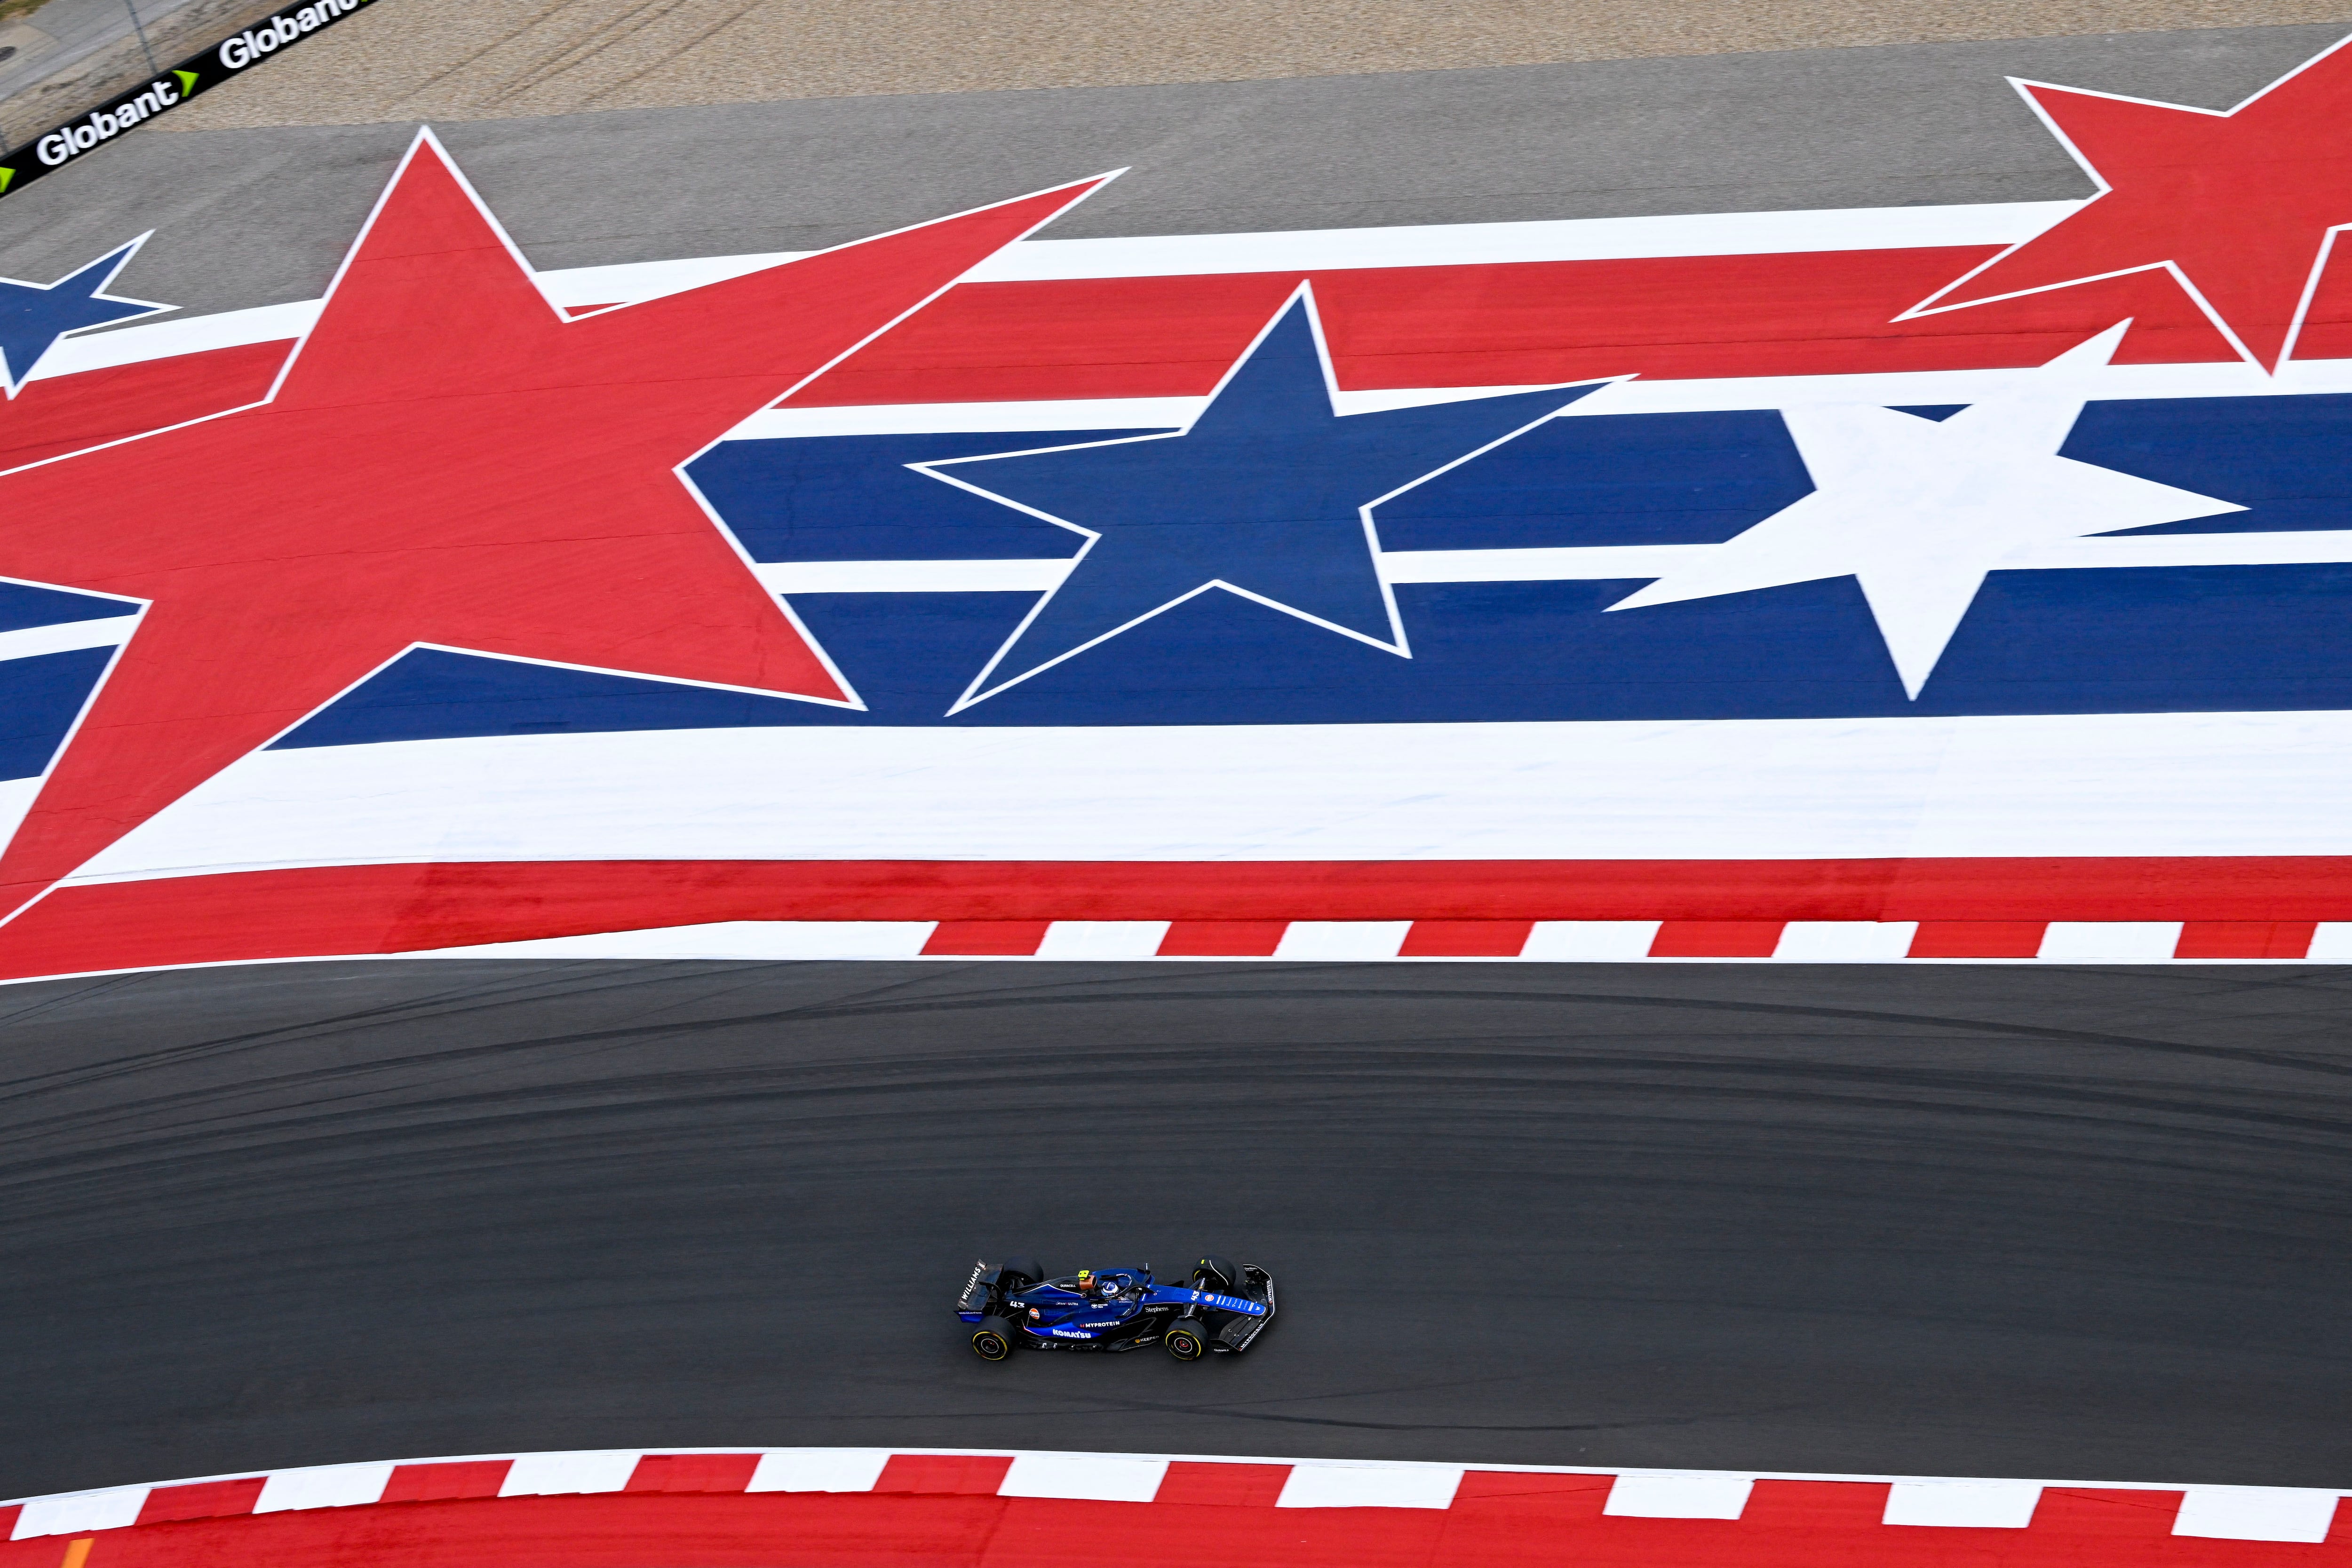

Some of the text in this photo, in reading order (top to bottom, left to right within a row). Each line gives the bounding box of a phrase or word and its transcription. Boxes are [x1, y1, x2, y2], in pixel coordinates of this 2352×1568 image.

[36, 81, 179, 166] Globant
[961, 1267, 981, 1300] WILLIAMS
[1190, 1291, 1200, 1301] 43
[1052, 1329, 1091, 1338] KOMATSU
[1240, 1323, 1263, 1348] MYPROTEIN
